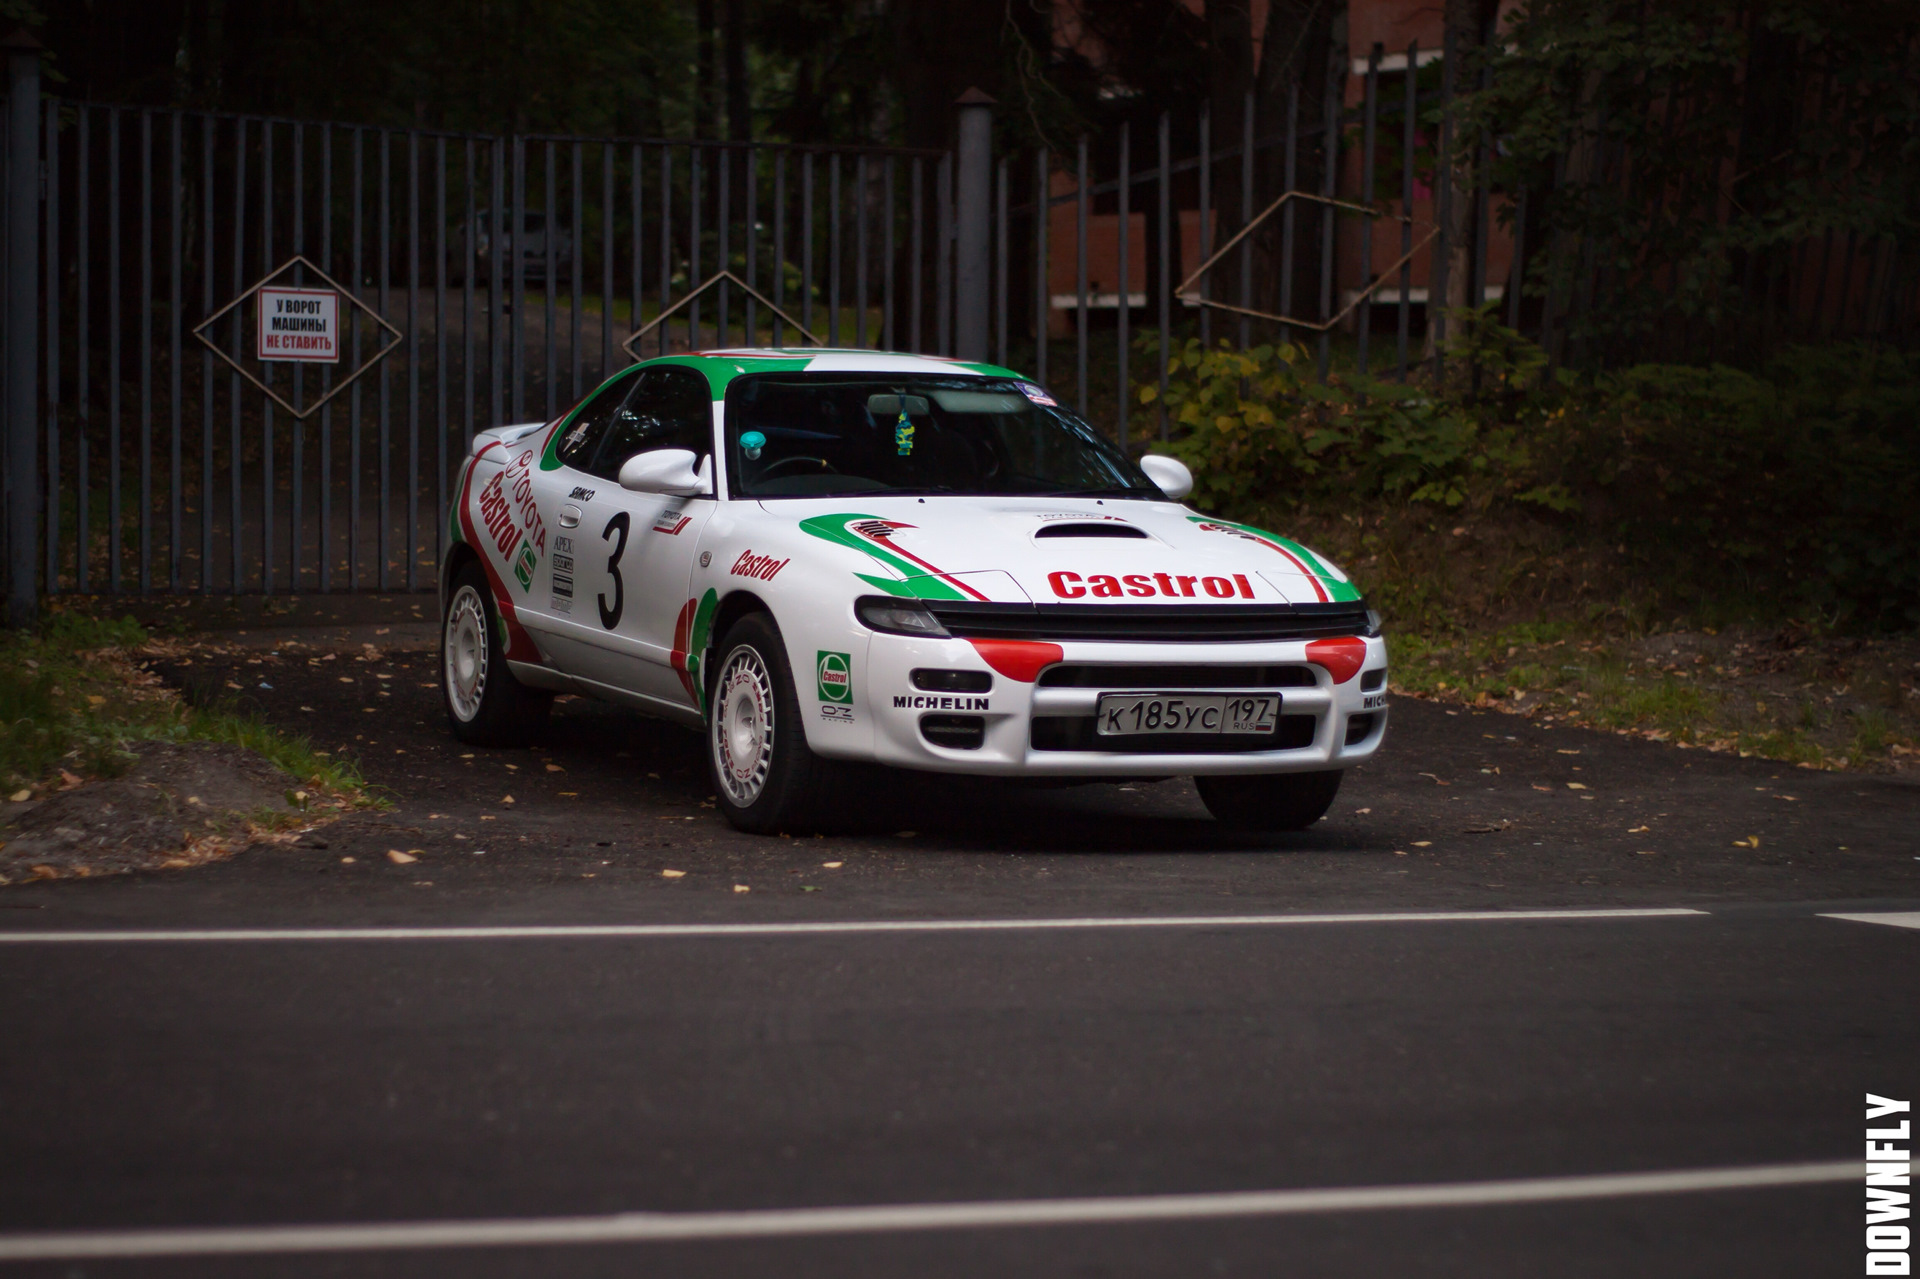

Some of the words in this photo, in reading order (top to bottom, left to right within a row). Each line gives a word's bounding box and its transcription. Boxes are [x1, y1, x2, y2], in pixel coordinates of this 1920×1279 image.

[276, 299, 283, 313] У
[286, 299, 321, 314] ВОРОТ
[272, 317, 326, 333] МАШИНЫ
[266, 334, 280, 349] НЕ
[282, 335, 331, 350] СТАВИТЬ
[479, 471, 524, 563] Castrol
[512, 468, 547, 558] TOYOTA
[597, 511, 631, 630] 3
[730, 549, 791, 582] Castrol
[1047, 571, 1256, 599] Castrol
[823, 671, 847, 683] Castrol
[893, 696, 990, 710] MICHELIN
[1228, 698, 1271, 723] 197
[1233, 721, 1255, 732] RUS
